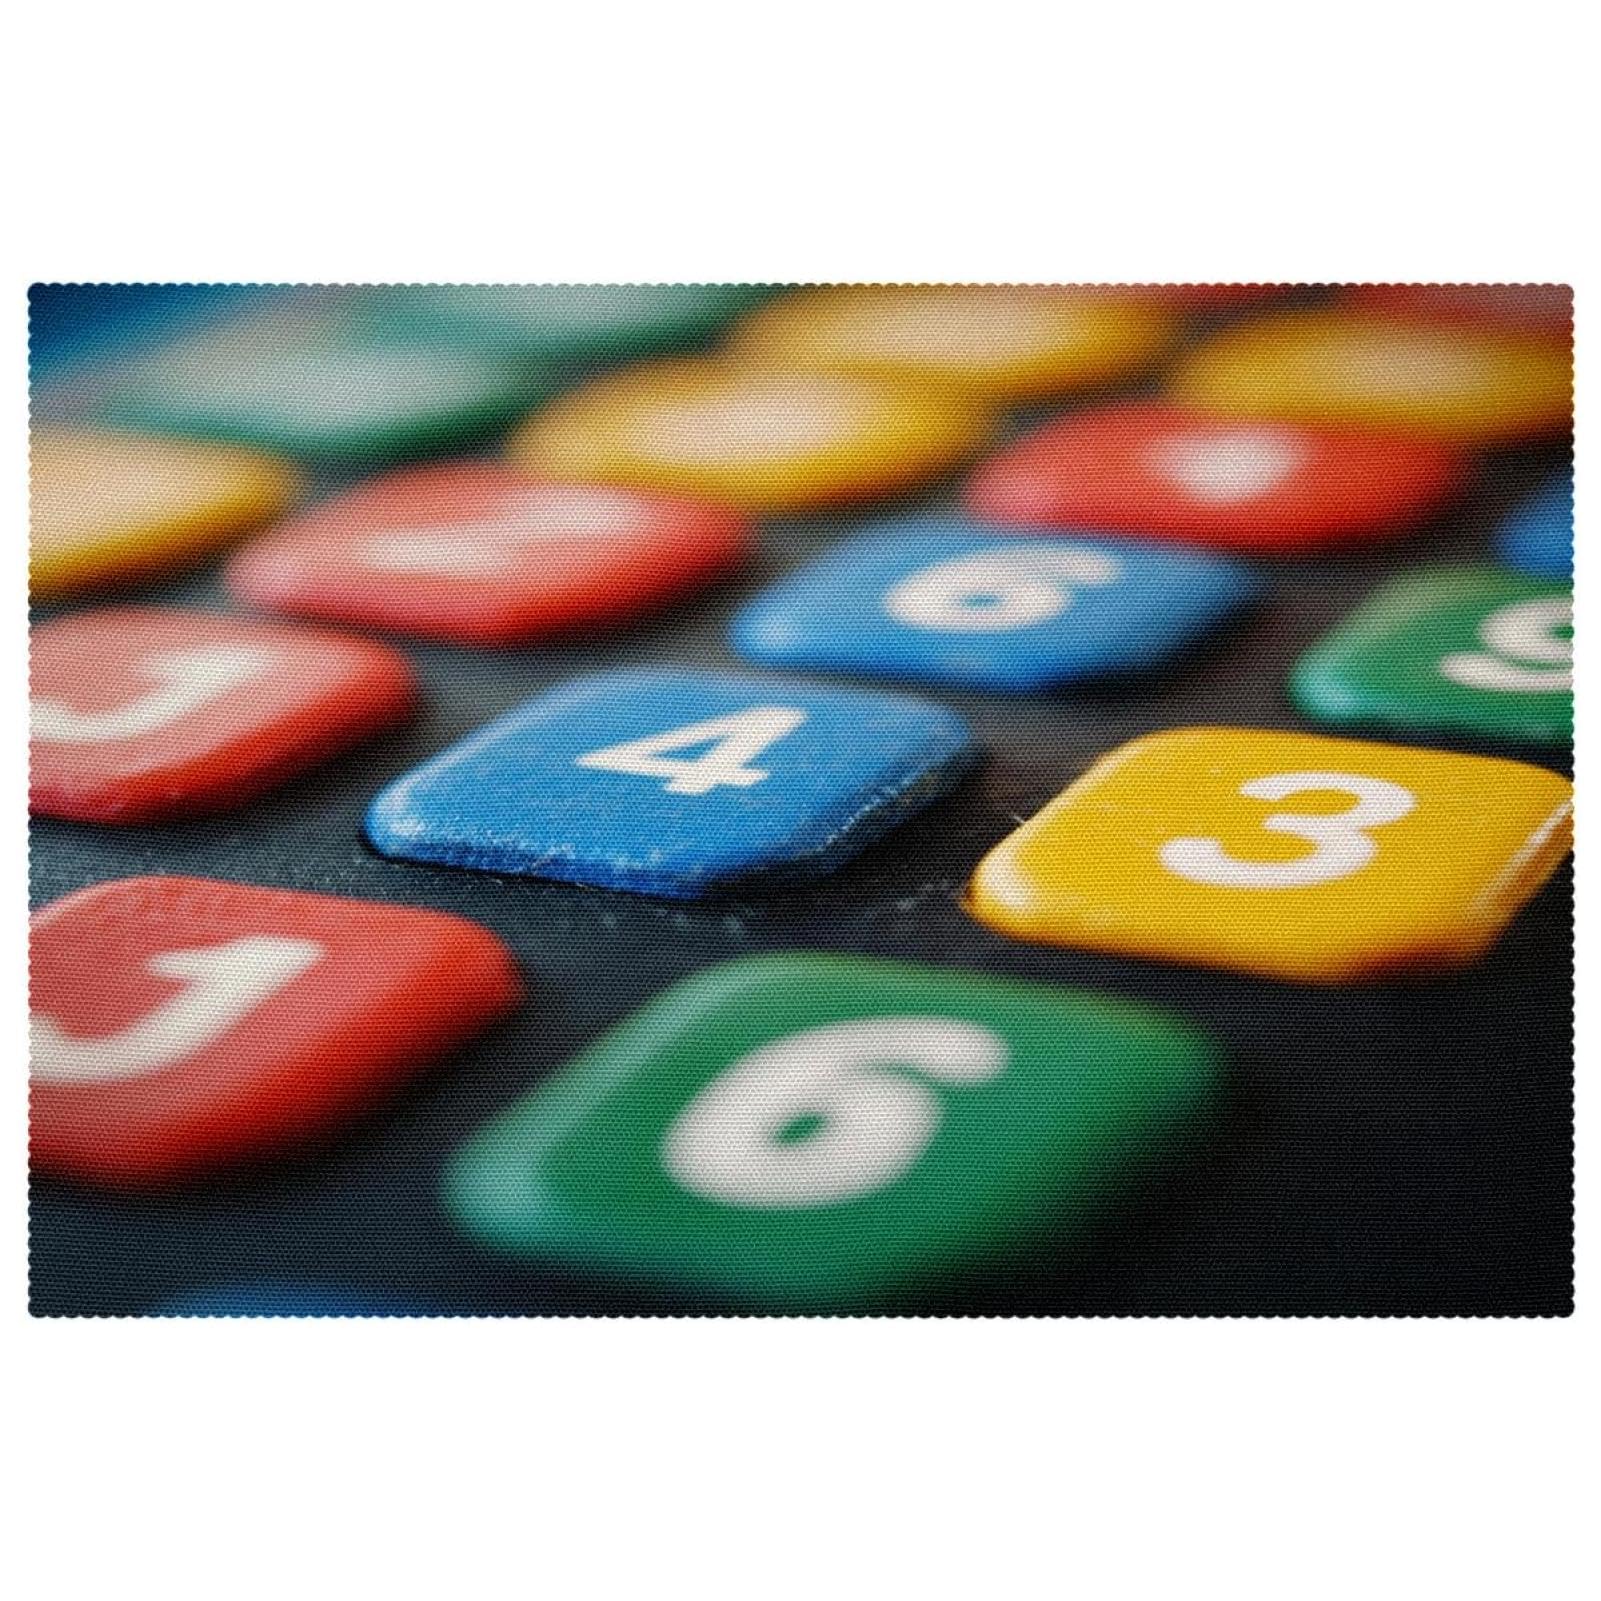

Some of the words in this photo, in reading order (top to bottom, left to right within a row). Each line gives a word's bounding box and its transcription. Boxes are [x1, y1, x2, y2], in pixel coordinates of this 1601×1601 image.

[884, 546, 1118, 631] 6
[578, 704, 807, 796] 4
[1159, 770, 1417, 890] 3
[662, 1015, 1009, 1209] 6
